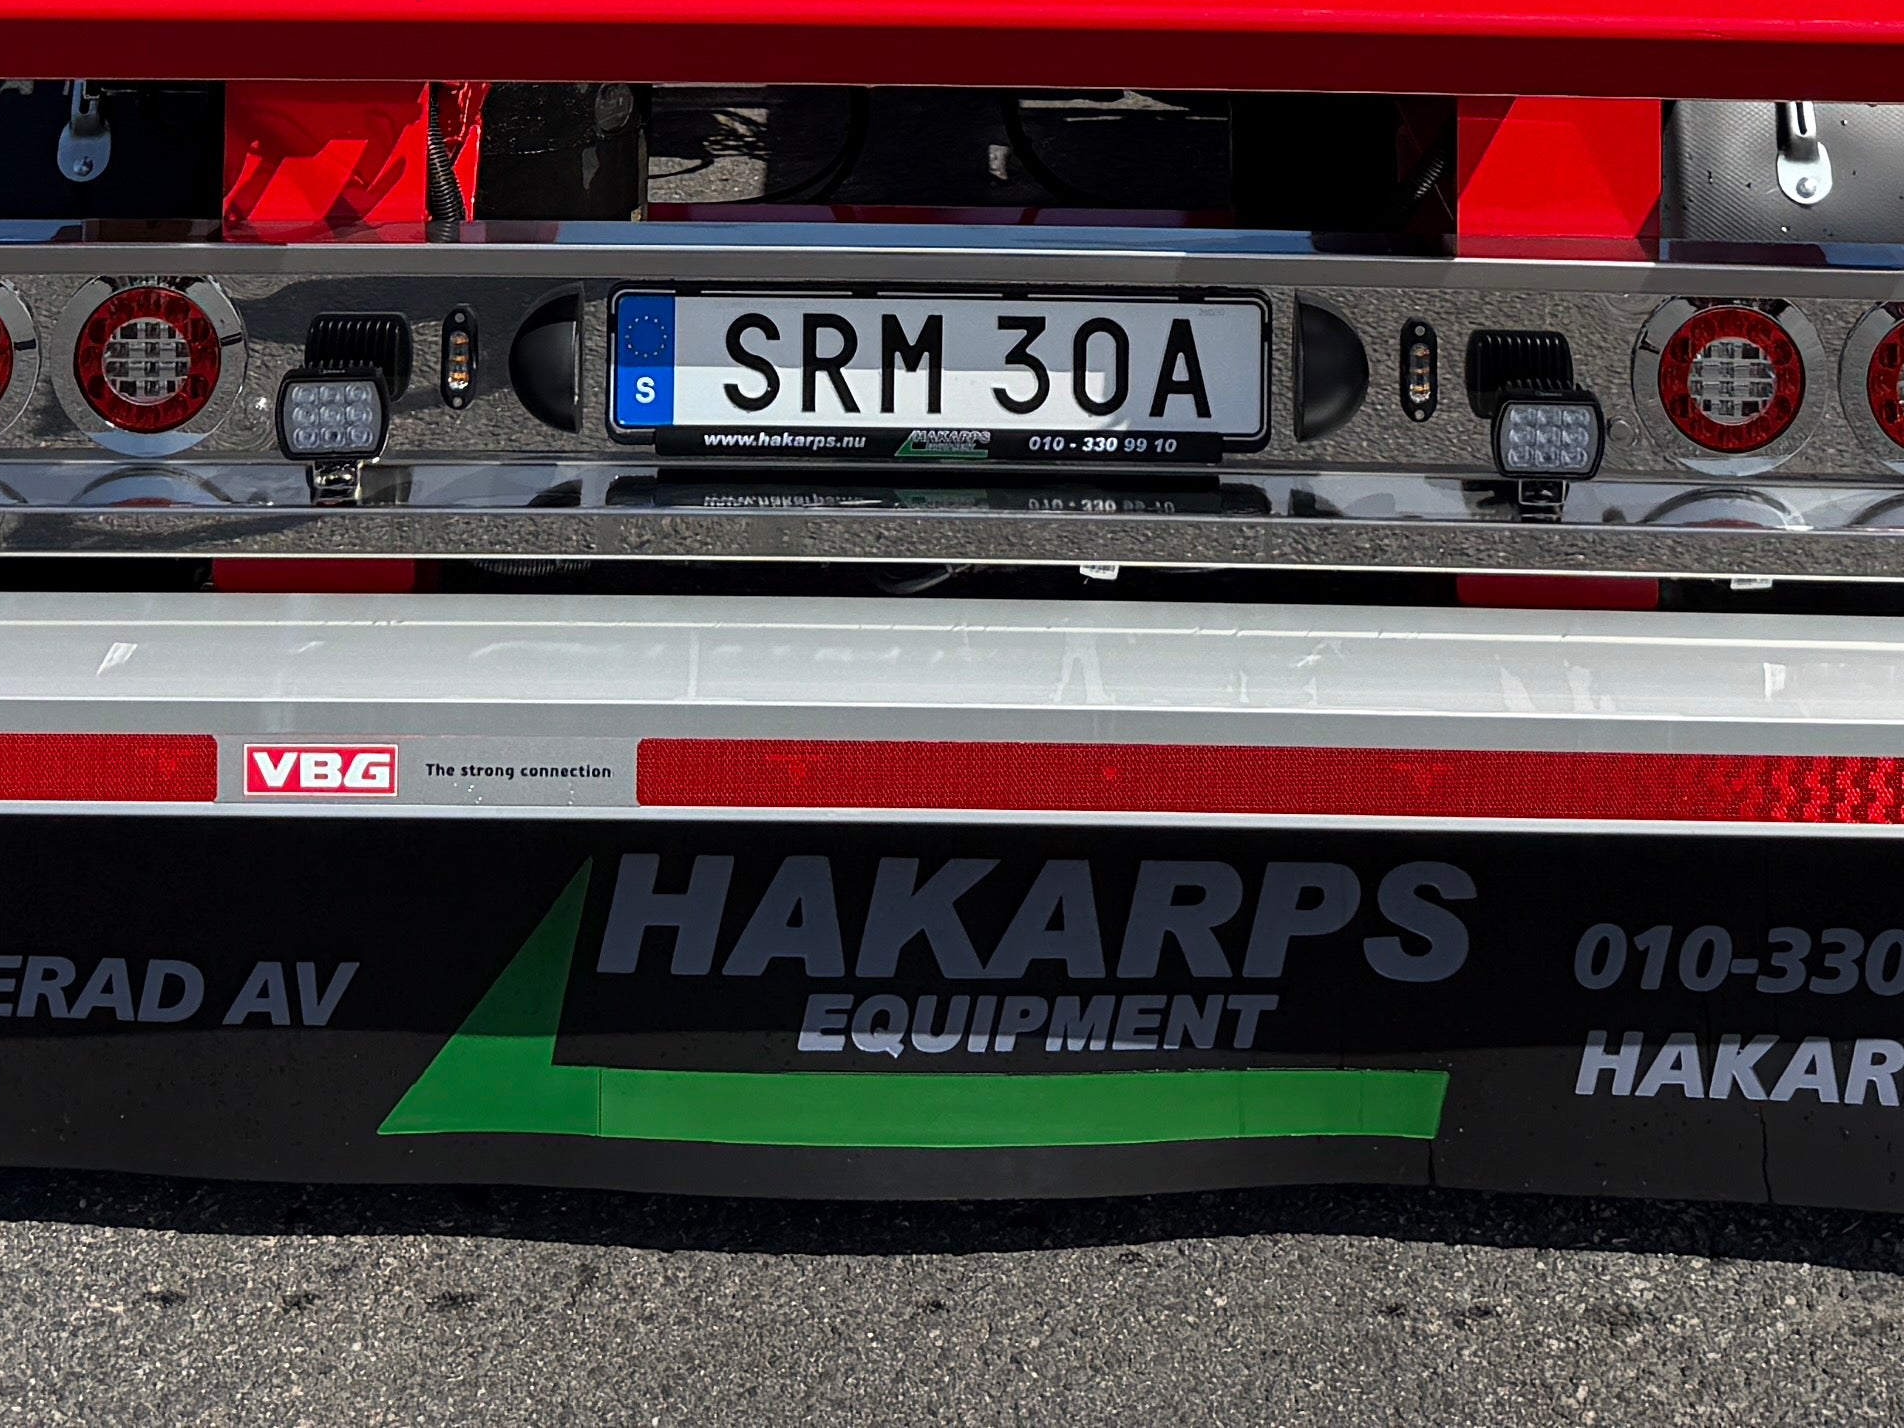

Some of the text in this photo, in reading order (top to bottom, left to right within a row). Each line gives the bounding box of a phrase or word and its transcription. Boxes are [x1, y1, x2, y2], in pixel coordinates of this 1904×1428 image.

[723, 312, 1212, 420] SRM 30A
[635, 376, 656, 404] S
[703, 430, 867, 451] www.hakarps.nu
[1028, 435, 1065, 452] 010
[1082, 436, 1118, 453] 330
[1124, 438, 1148, 453] 99
[1154, 439, 1177, 454] 10
[253, 752, 390, 788] VBG
[425, 762, 612, 781] The strong connection
[596, 852, 1480, 983] HAKARPS
[222, 961, 360, 1028] AV
[797, 992, 1279, 1059] EQUIPMENT
